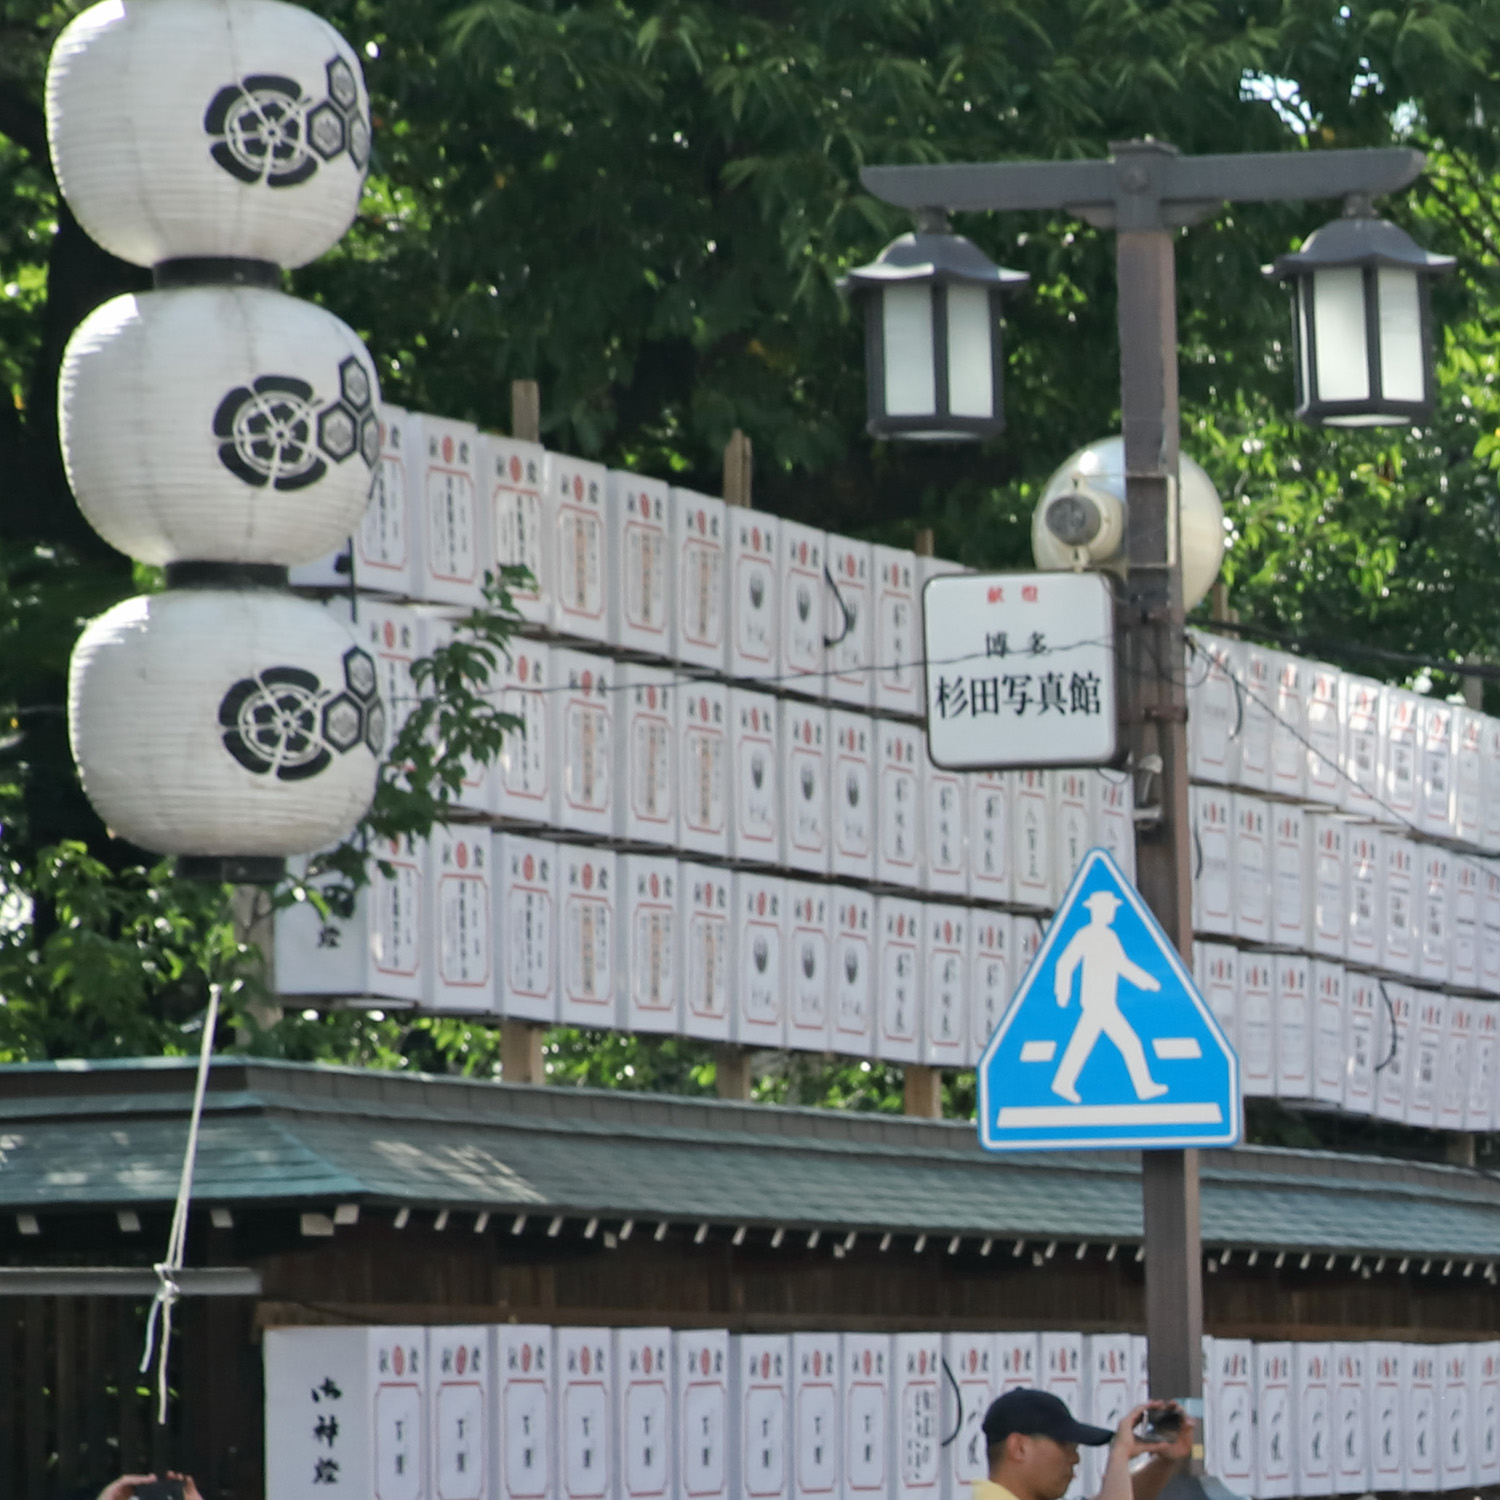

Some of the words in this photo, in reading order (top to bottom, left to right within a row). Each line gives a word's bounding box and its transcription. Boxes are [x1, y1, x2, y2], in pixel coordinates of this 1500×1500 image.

[984, 631, 1050, 659] 博多
[935, 671, 1102, 720] 杉田写真館
